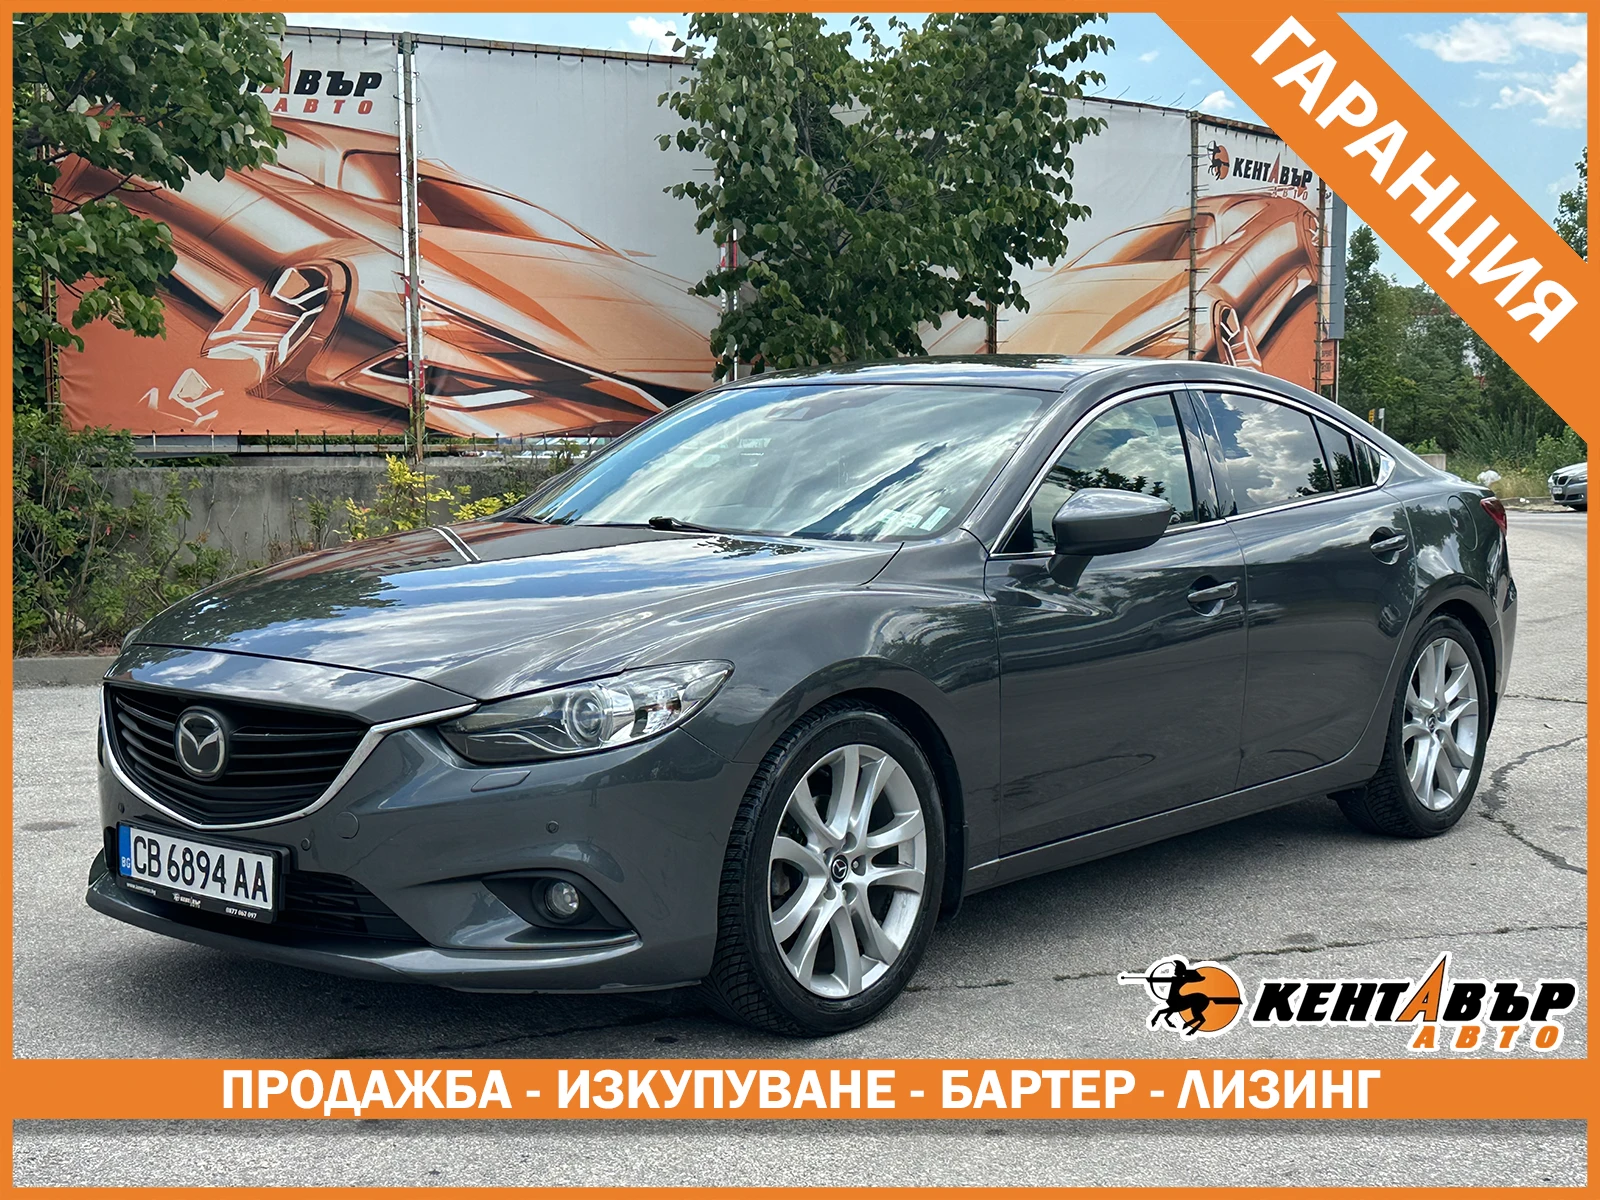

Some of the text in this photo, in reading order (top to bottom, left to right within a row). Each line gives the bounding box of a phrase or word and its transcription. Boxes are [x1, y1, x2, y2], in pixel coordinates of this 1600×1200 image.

[247, 50, 382, 97] АВЪР
[273, 97, 374, 115] АВТО
[1233, 152, 1313, 188] КЕНТАВЪР
[121, 856, 131, 869] BG
[133, 835, 268, 903] CB 6894 AA
